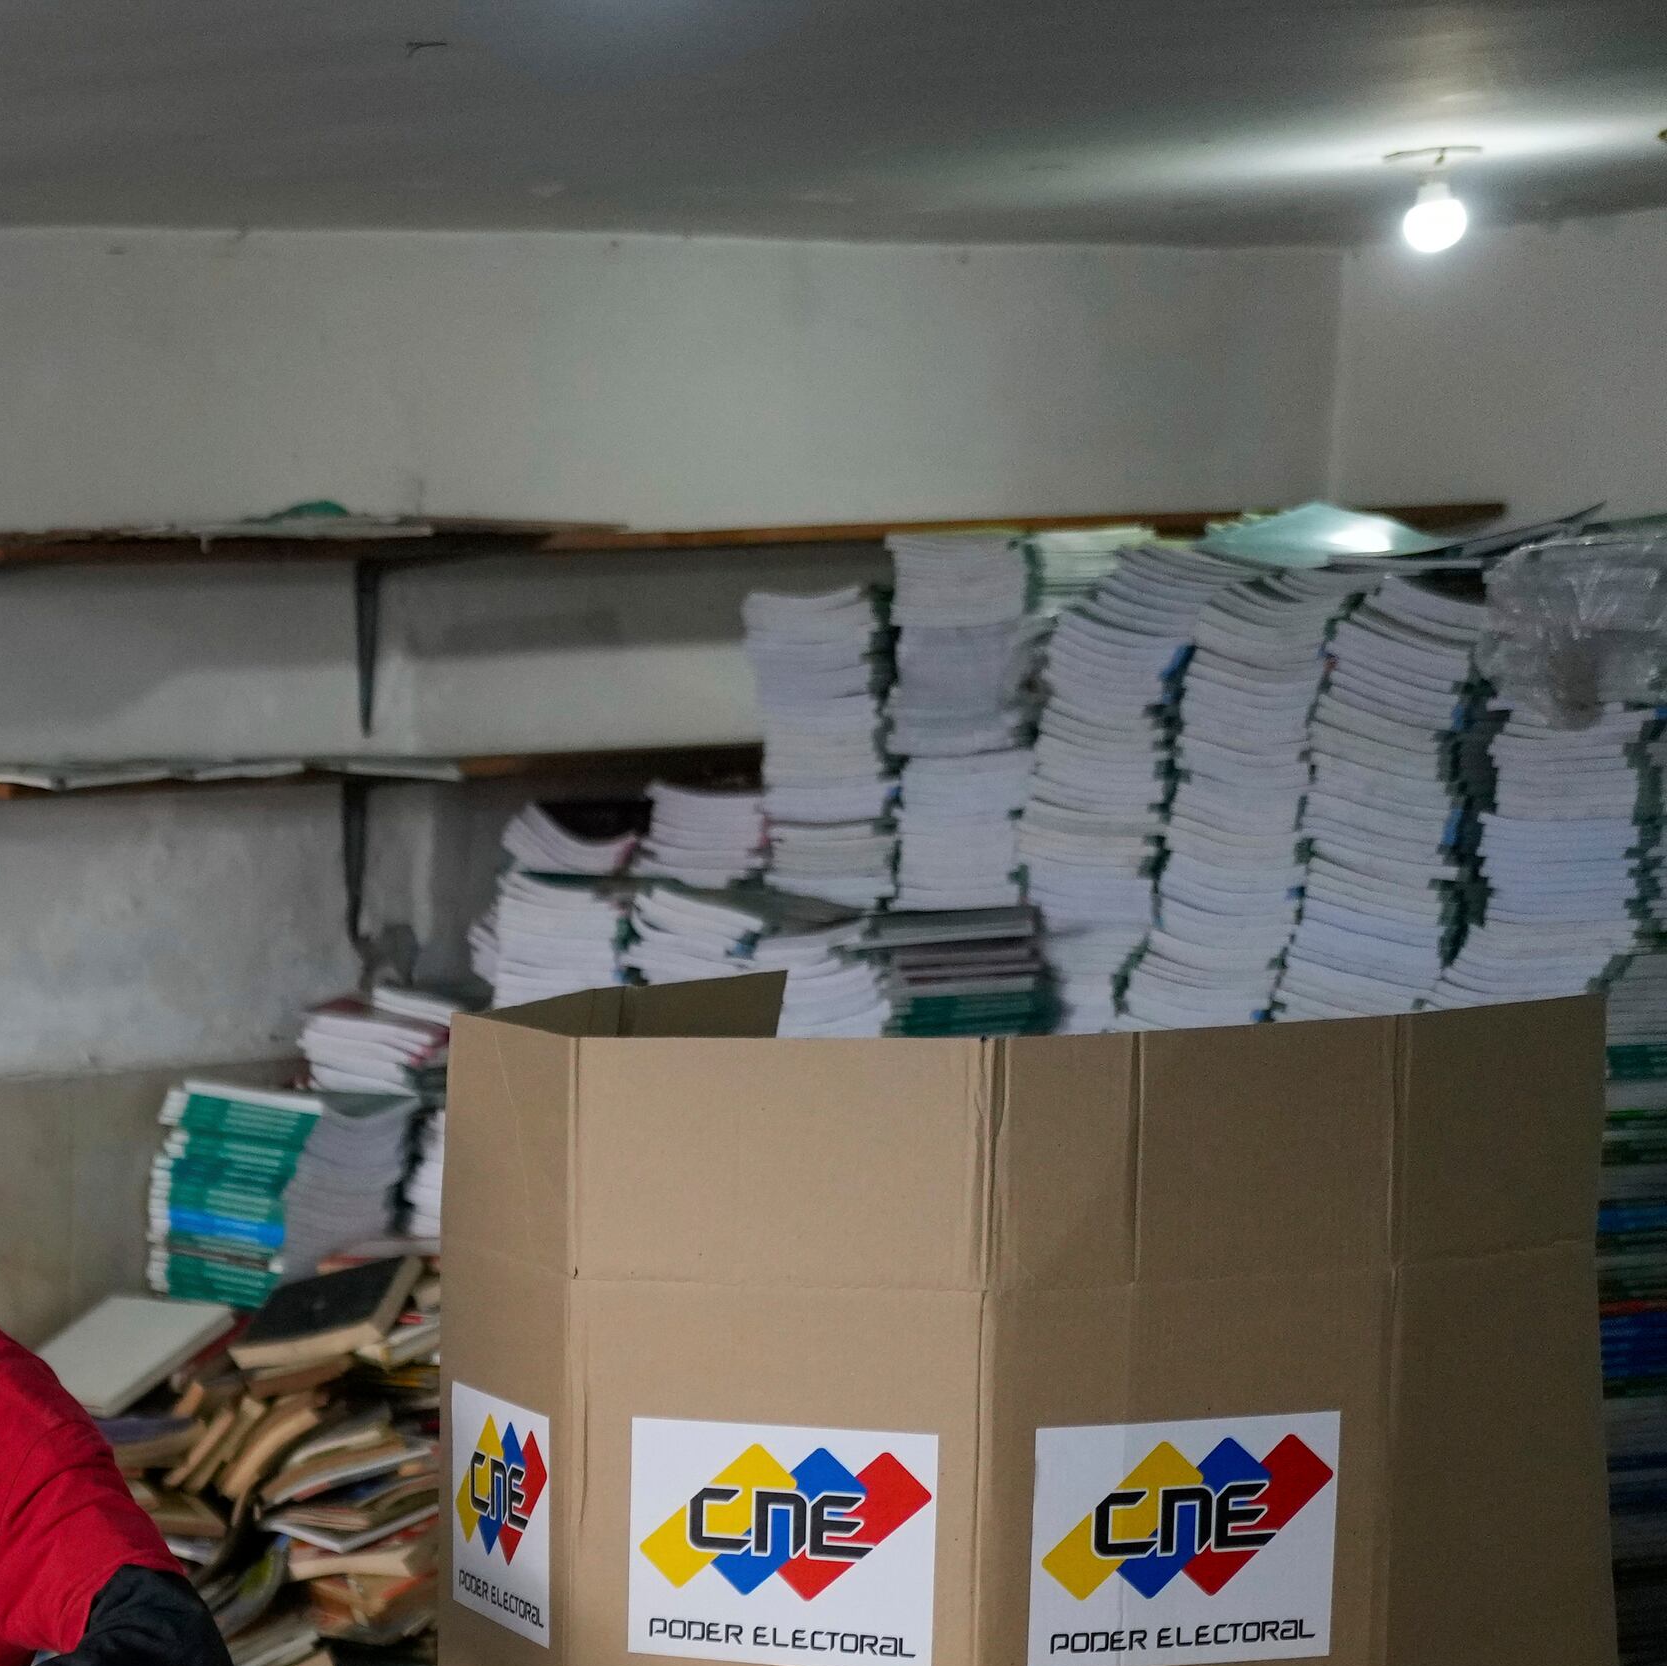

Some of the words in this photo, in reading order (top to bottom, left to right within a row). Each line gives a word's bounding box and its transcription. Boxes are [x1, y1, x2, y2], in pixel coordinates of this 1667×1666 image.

[470, 1450, 530, 1532] CNE
[686, 1486, 876, 1560] CNE
[1094, 1480, 1278, 1558] CNE
[458, 1569, 489, 1601] PODER
[490, 1585, 545, 1629] ELECTORAL
[649, 1617, 743, 1646] PODER
[752, 1624, 916, 1659] ELECTORAL
[1049, 1628, 1149, 1655] PODER
[1156, 1618, 1316, 1651] ELECTORAL
